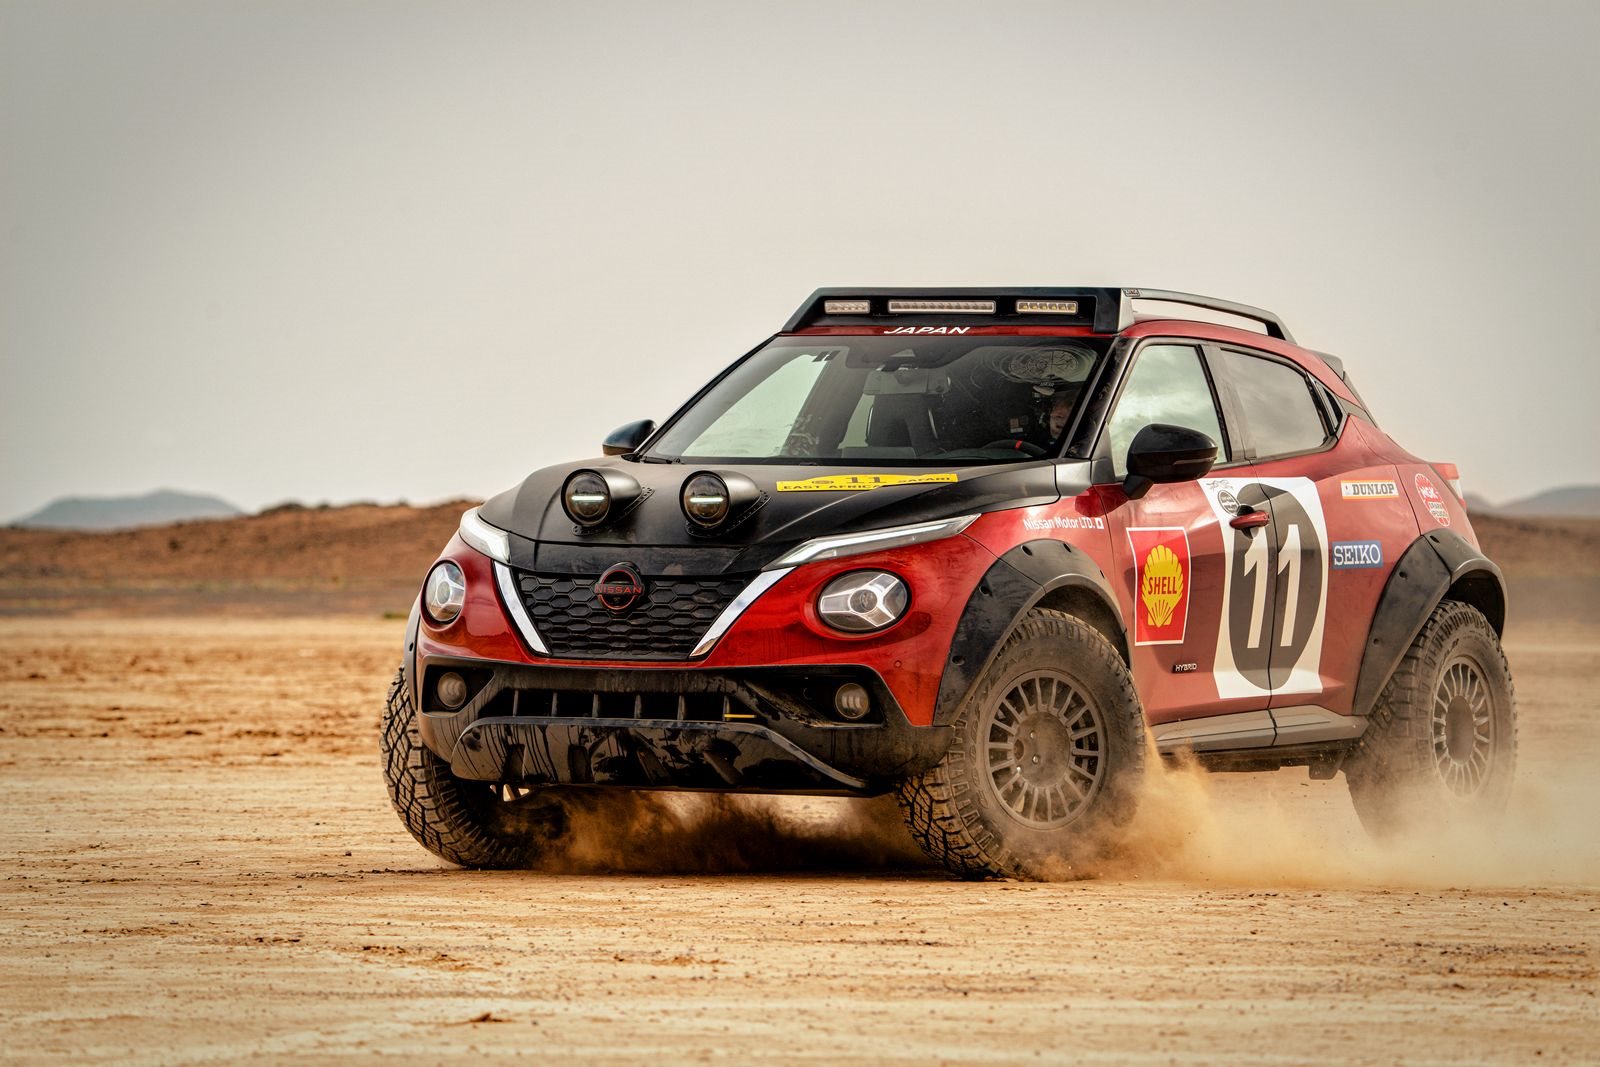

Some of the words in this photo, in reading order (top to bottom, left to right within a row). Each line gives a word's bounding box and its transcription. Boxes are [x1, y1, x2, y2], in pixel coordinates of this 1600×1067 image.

[884, 326, 971, 334] JAPAN
[846, 476, 887, 484] 11
[1352, 483, 1395, 495] DUNLOP
[1023, 518, 1054, 529] Nissan
[1055, 517, 1079, 529] Motor
[1079, 517, 1096, 529] LTD.
[1333, 543, 1381, 566] SEIKO
[595, 585, 642, 594] NISSAN
[1147, 576, 1178, 595] SHELL
[1243, 523, 1302, 649] 11
[1175, 663, 1198, 672] HYBRID
